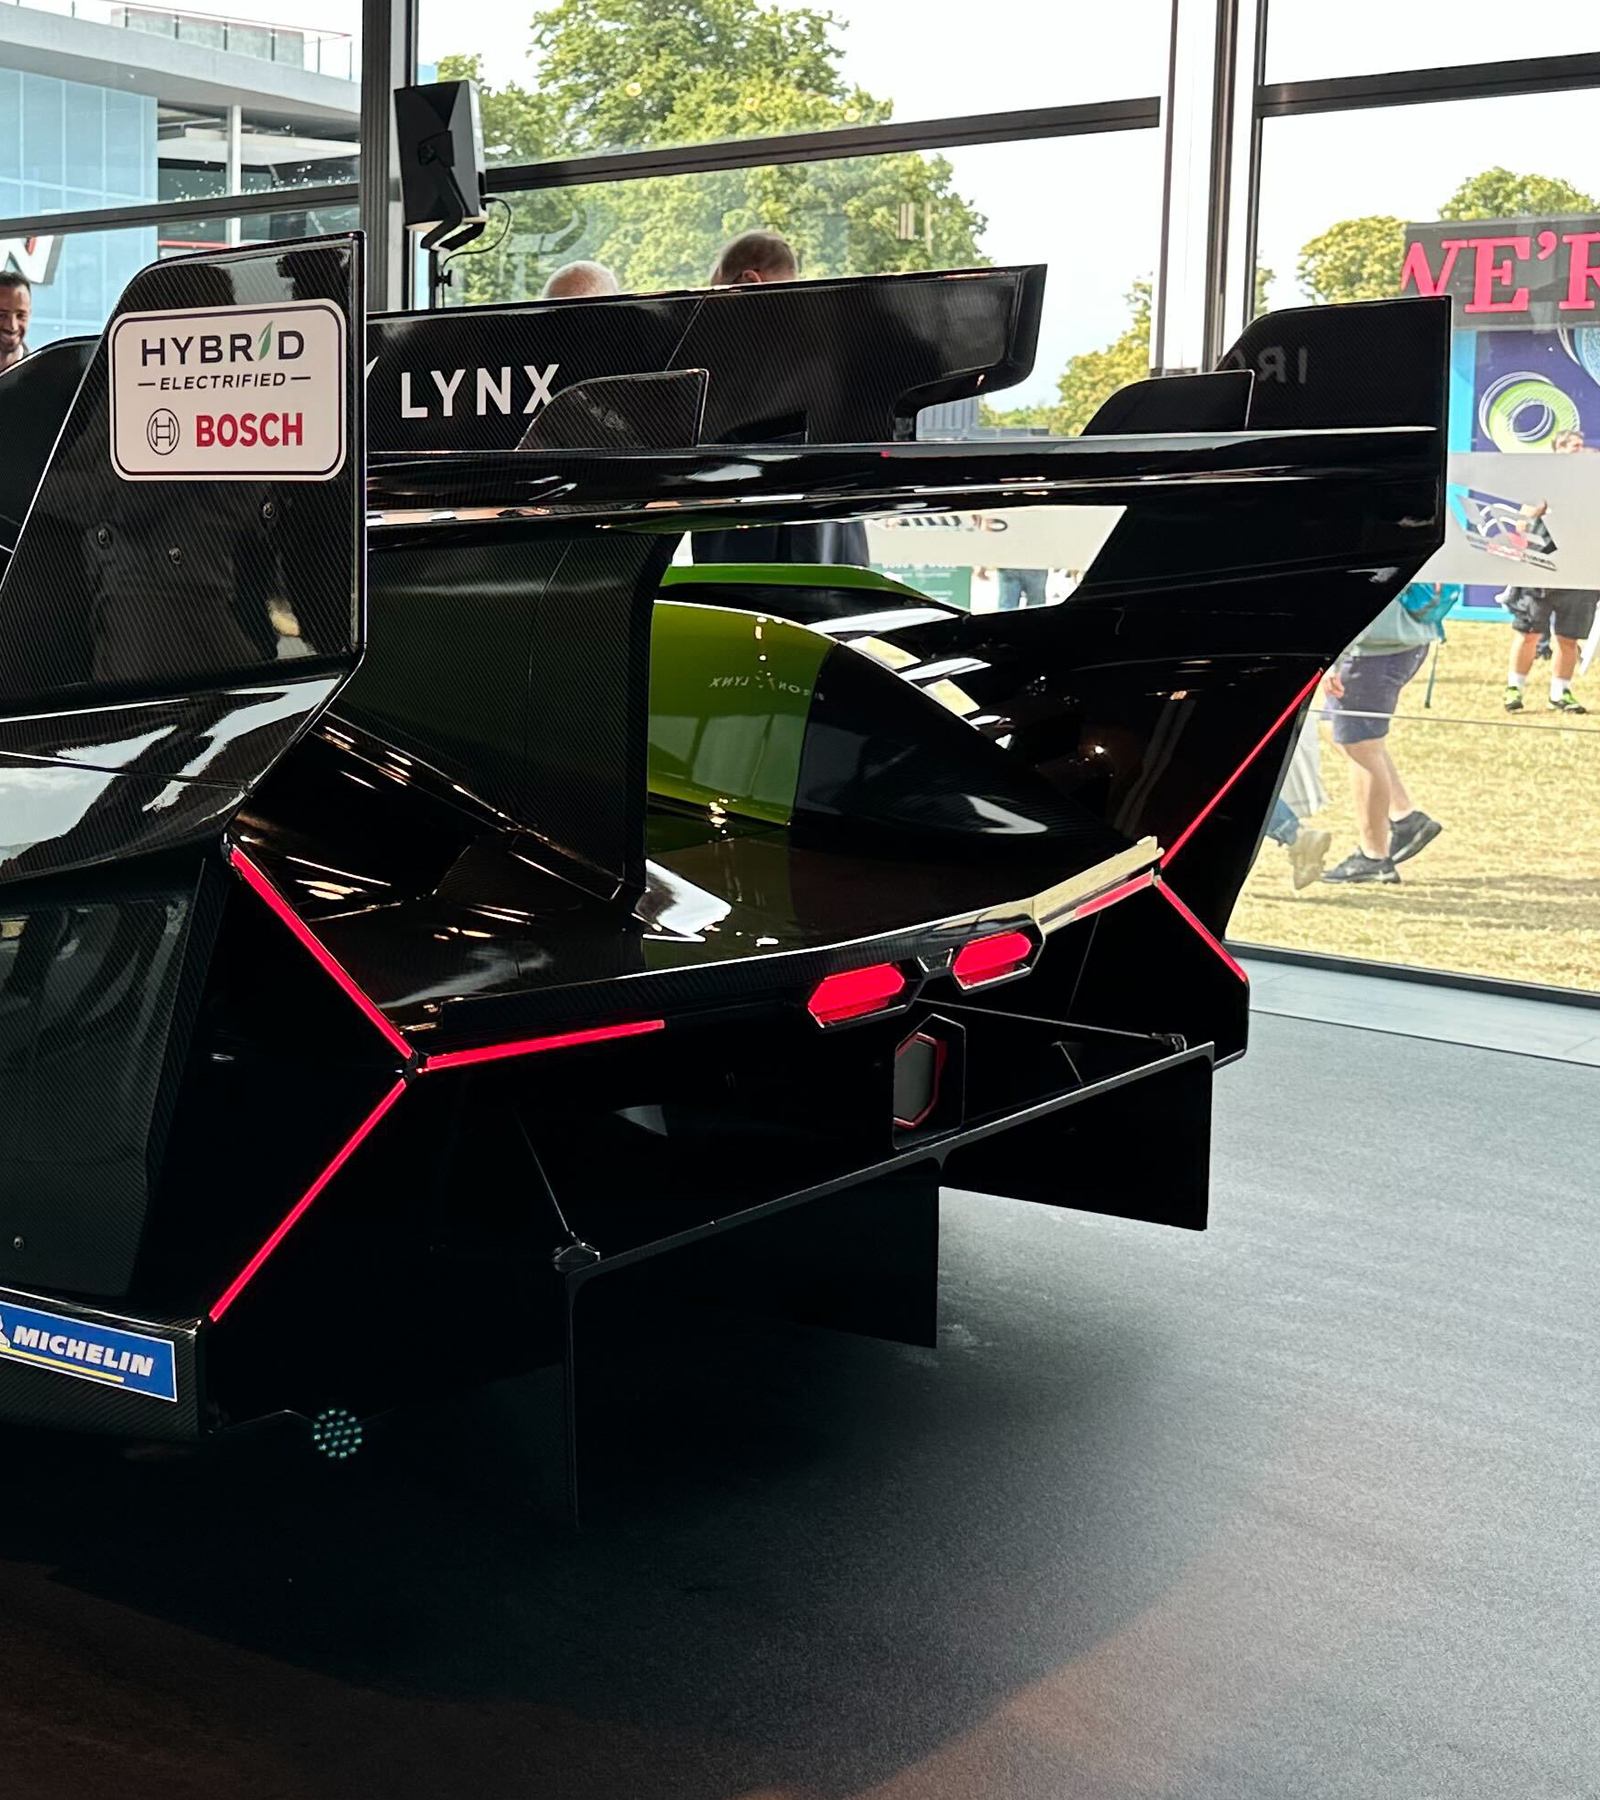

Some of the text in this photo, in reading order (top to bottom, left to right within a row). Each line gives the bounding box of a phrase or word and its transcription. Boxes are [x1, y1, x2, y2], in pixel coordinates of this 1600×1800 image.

[141, 321, 305, 367] HYBRID
[160, 372, 287, 391] ELECTRIFIED
[401, 363, 560, 418] LYNX
[196, 412, 304, 448] BOSCH
[13, 1326, 154, 1377] MICHELIN
